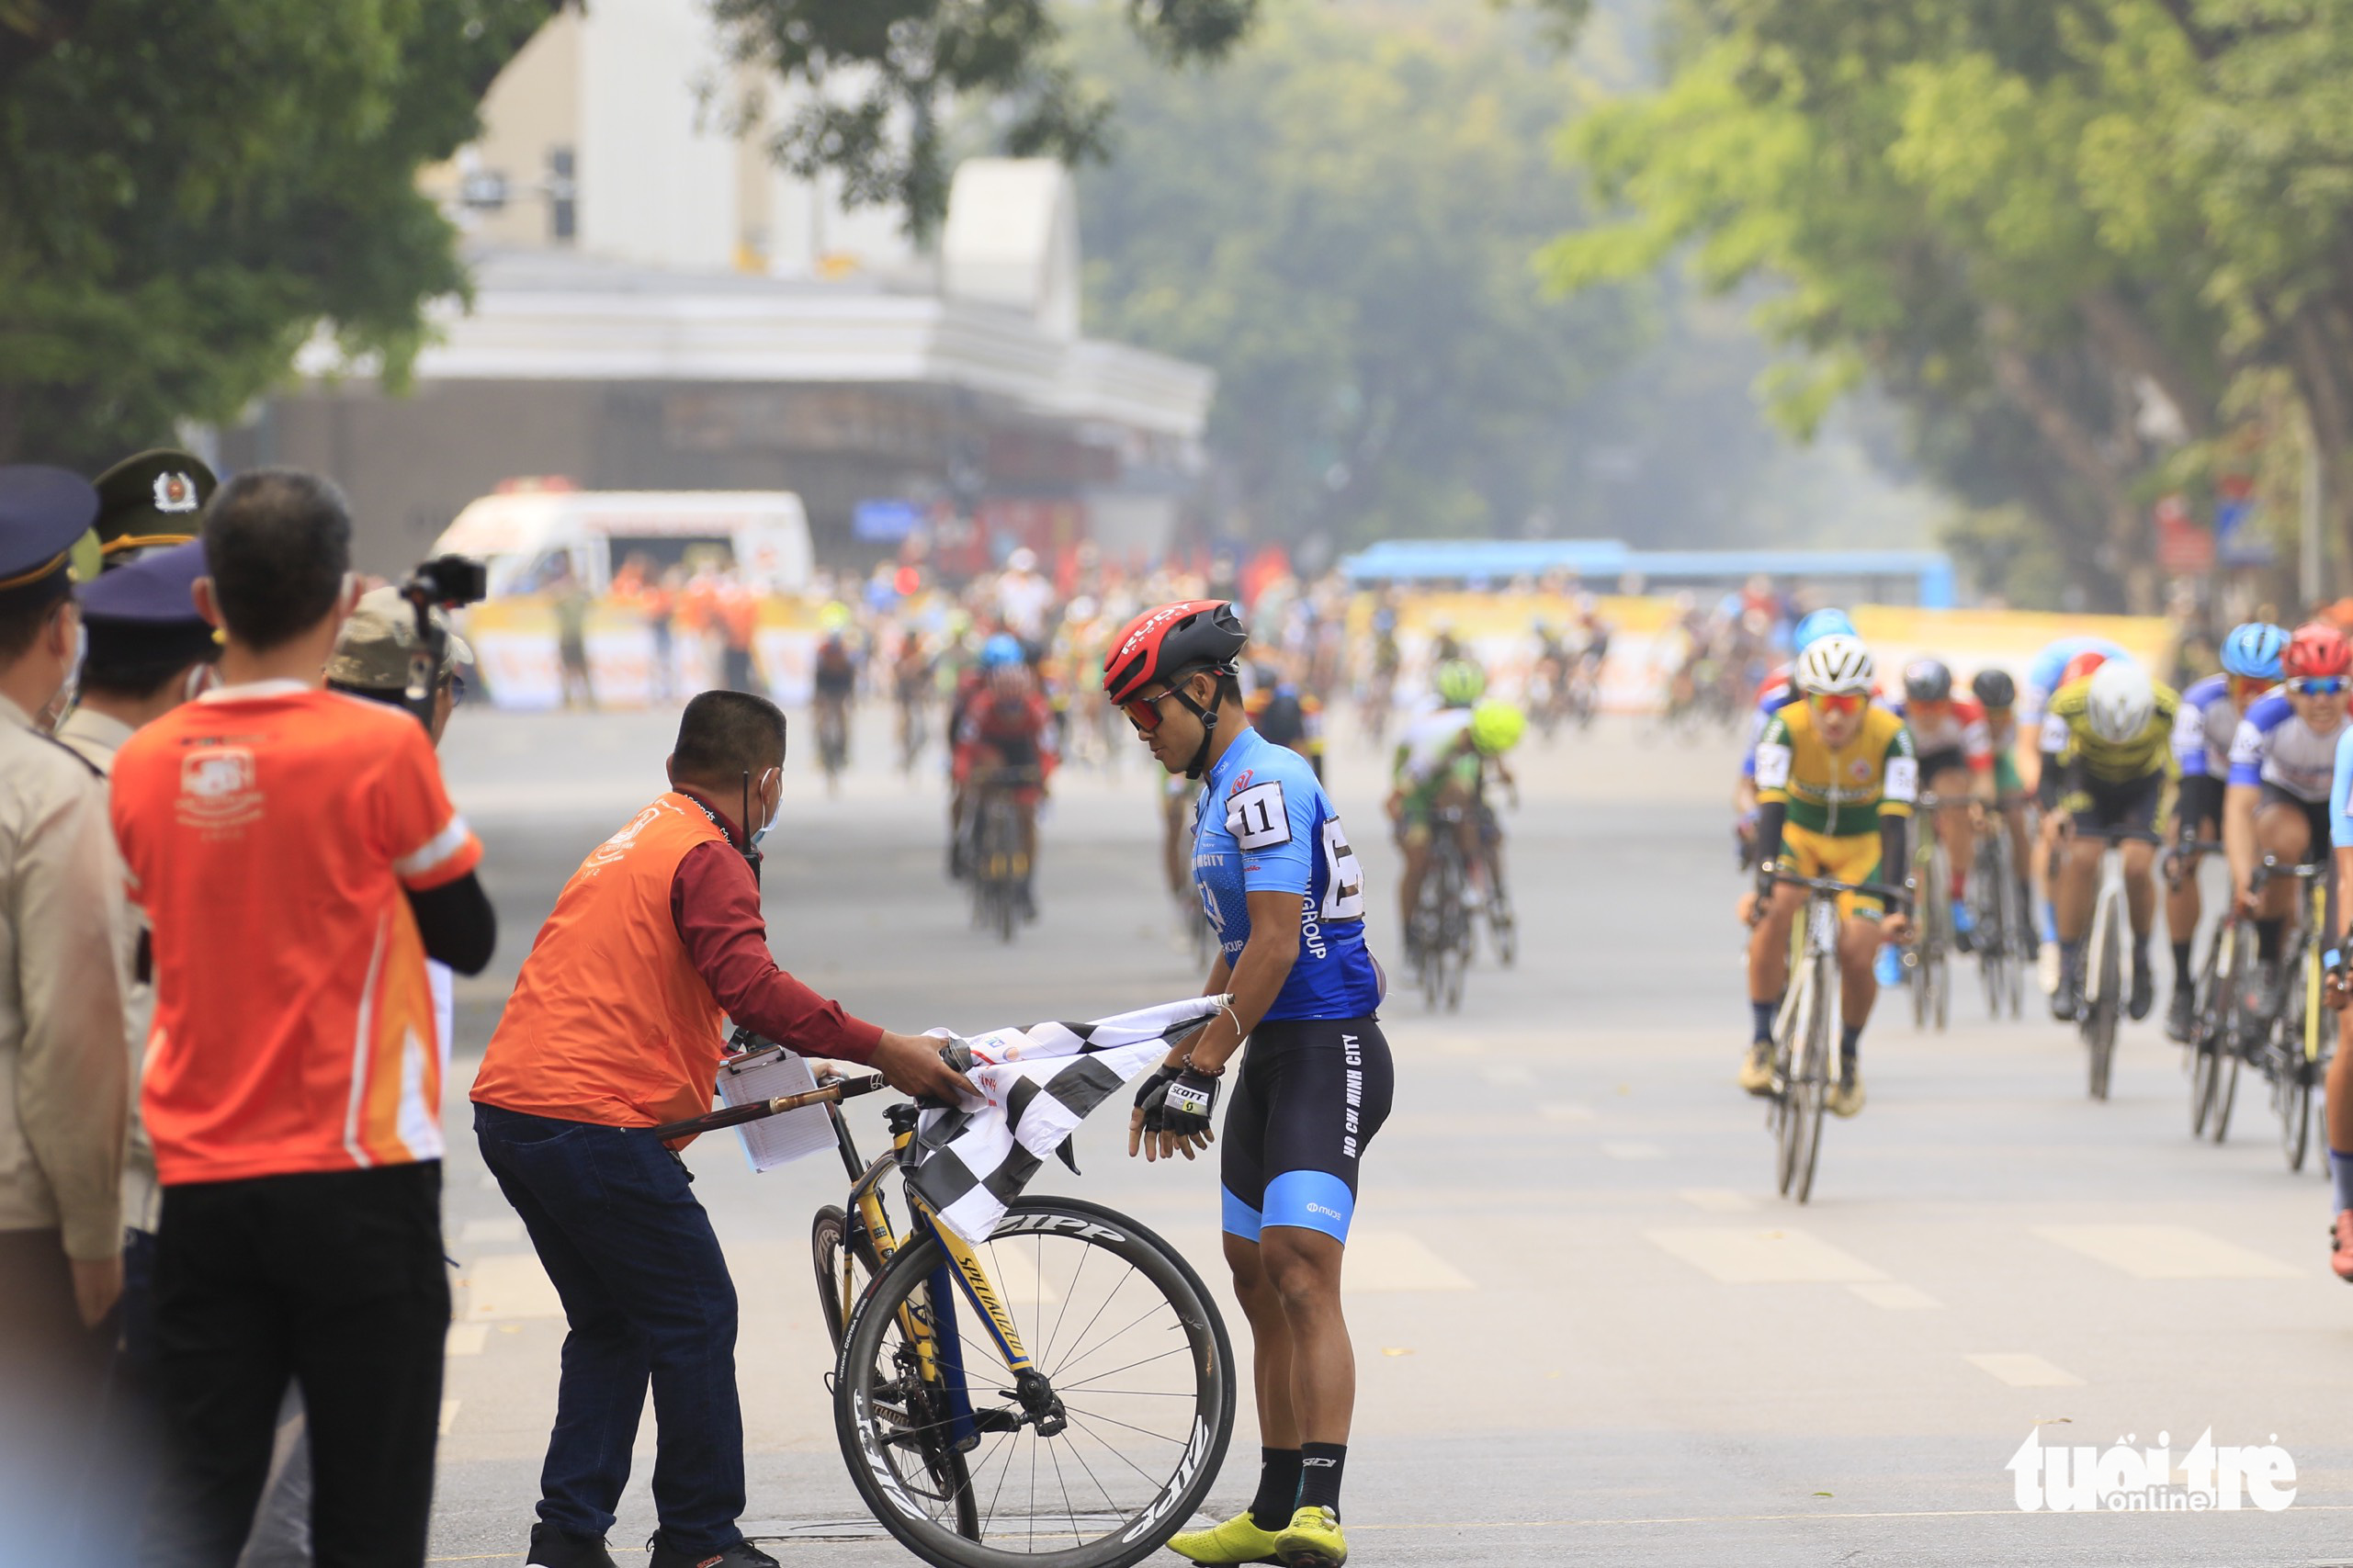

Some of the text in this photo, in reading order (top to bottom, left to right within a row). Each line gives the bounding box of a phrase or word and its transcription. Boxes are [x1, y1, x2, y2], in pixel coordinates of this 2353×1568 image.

[1122, 603, 1190, 655] RUDY
[1131, 608, 1191, 651] PROJECT
[1238, 797, 1275, 837] 11
[1171, 1086, 1205, 1100] SCOTT
[1341, 1033, 1363, 1158] HO CHI MINH CITY
[990, 1213, 1126, 1242] ZIPP
[956, 1255, 1024, 1352] SPECIALIZED
[1122, 1415, 1210, 1544] ZIPP
